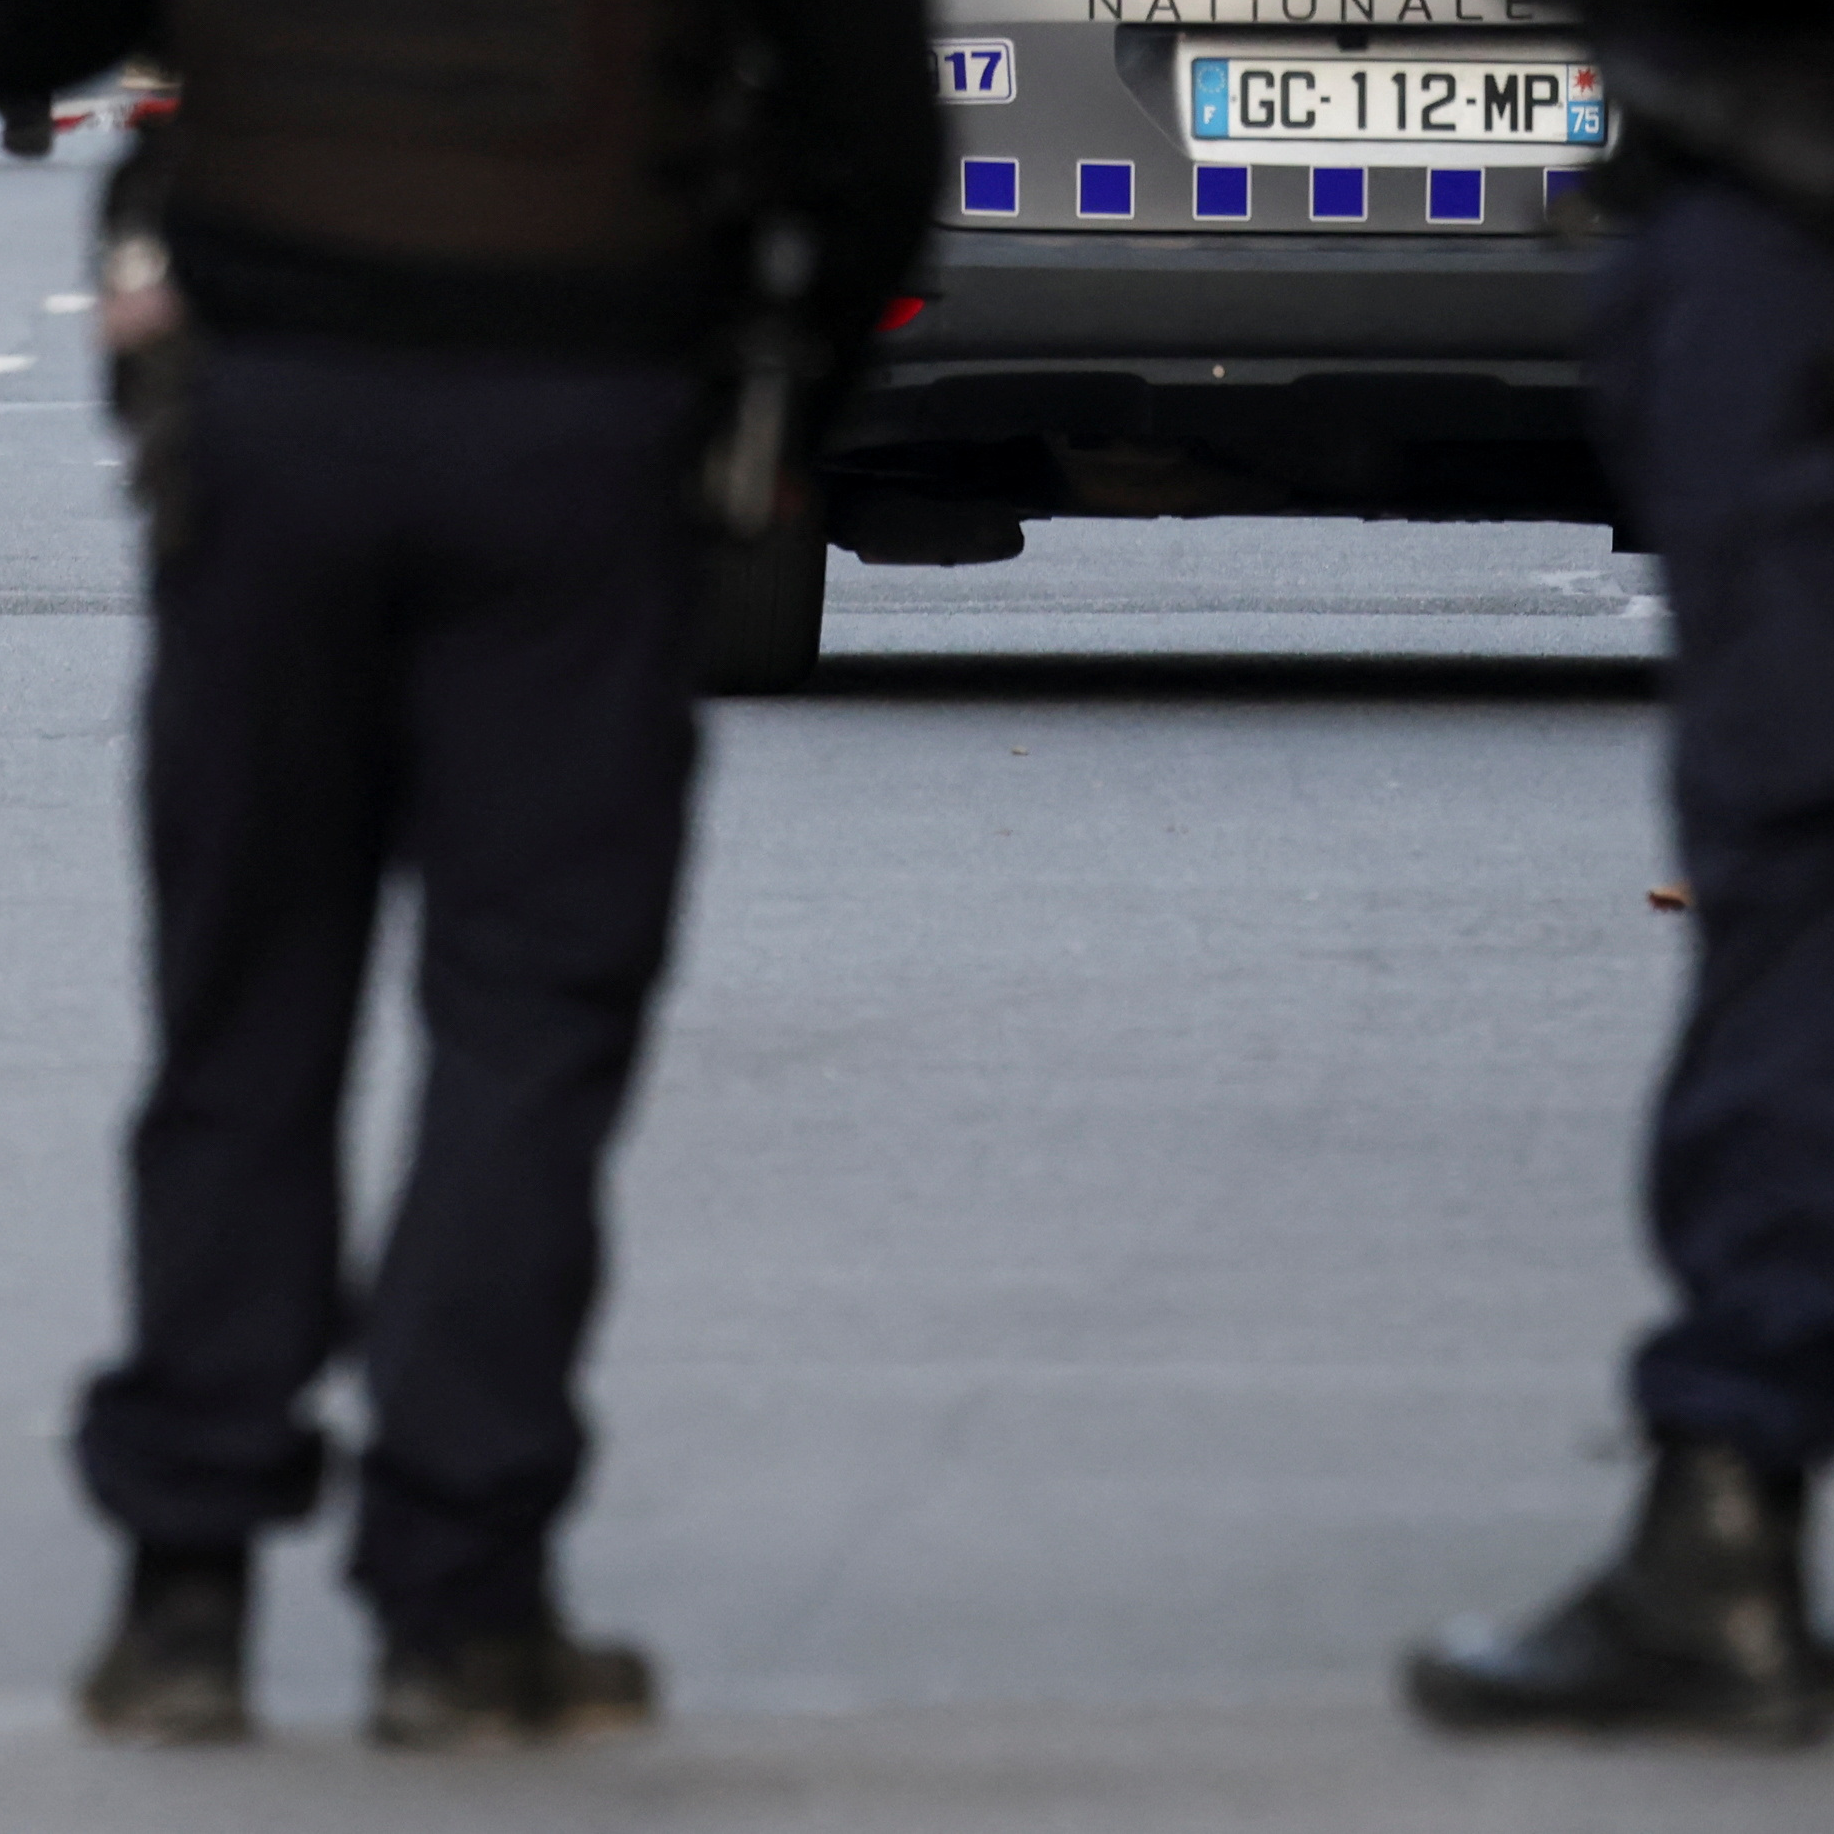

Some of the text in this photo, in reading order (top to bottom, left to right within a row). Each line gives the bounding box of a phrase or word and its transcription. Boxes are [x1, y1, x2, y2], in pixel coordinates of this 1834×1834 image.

[944, 50, 1002, 92] 17
[1239, 70, 1561, 133] GC-112-MP
[1571, 106, 1601, 134] 75
